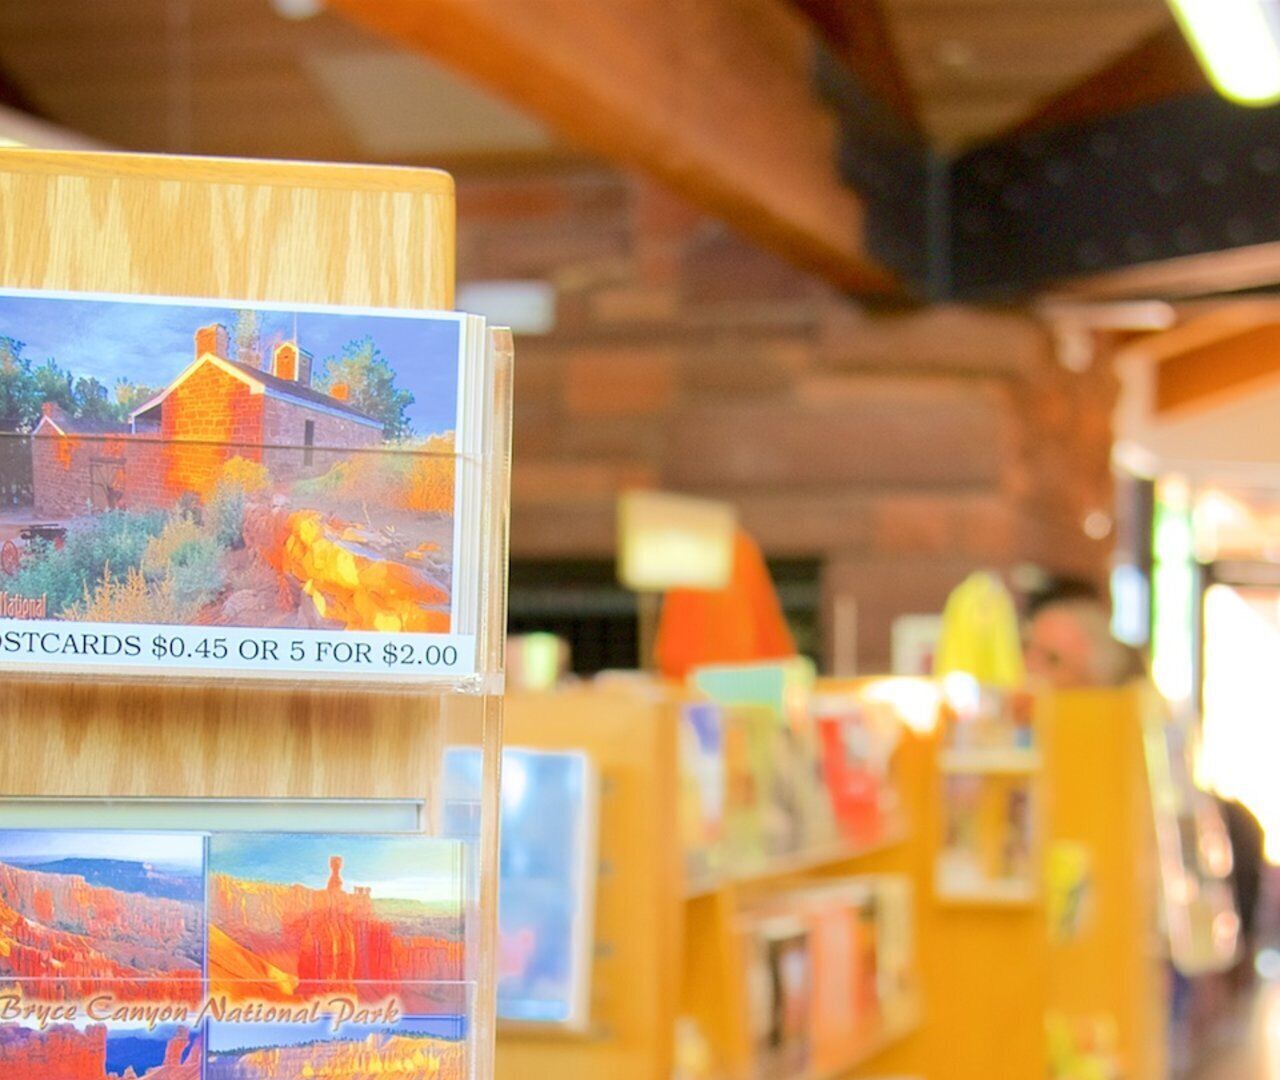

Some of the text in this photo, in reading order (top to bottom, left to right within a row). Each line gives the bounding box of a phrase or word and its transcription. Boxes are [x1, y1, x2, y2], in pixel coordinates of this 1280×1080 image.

[152, 635, 228, 660] $0.45
[239, 639, 278, 661] OR
[290, 640, 305, 662] 5
[316, 641, 372, 664] FOR
[382, 643, 458, 667] $2.00
[86, 995, 188, 1032] Canyon
[195, 995, 318, 1028] National
[322, 996, 402, 1031] Park
